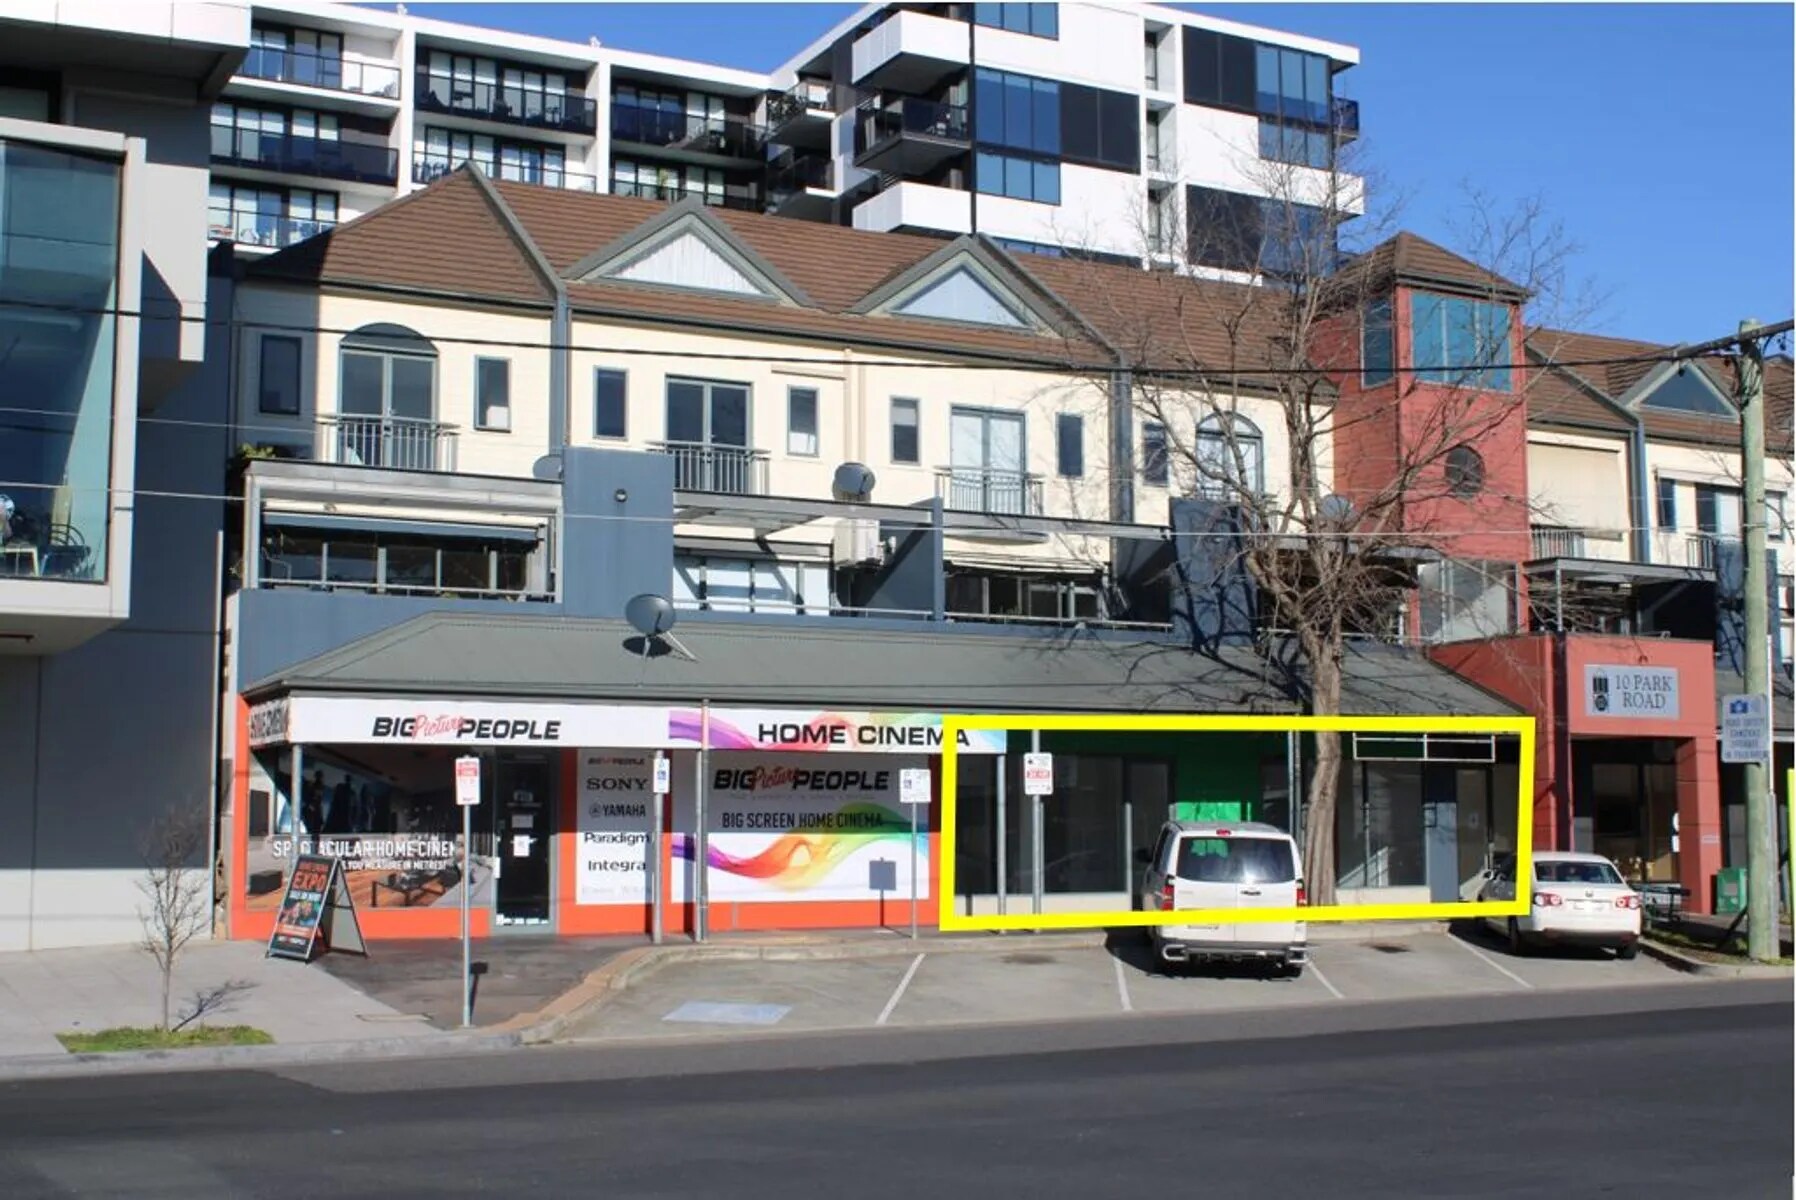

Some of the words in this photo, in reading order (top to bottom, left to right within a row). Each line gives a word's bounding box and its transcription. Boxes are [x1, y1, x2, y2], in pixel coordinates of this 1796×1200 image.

[1615, 674, 1630, 690] 10
[1633, 674, 1673, 692] PARK
[1622, 691, 1666, 709] ROAD
[372, 716, 416, 737] BIG
[456, 718, 561, 740] PEOPLE
[758, 723, 846, 744] HOME
[586, 777, 648, 791] SONY
[713, 769, 755, 790] BIG
[791, 770, 889, 791] PEOPLE
[602, 803, 646, 817] YAMAHA
[722, 812, 744, 829] BIG
[747, 812, 795, 829] SCREEN
[799, 812, 833, 829] HOME
[836, 812, 883, 829] CINEMA
[584, 832, 650, 847] Paradigm
[375, 840, 415, 857] HOME
[587, 860, 647, 872] Integra
[292, 870, 327, 893] EXPO
